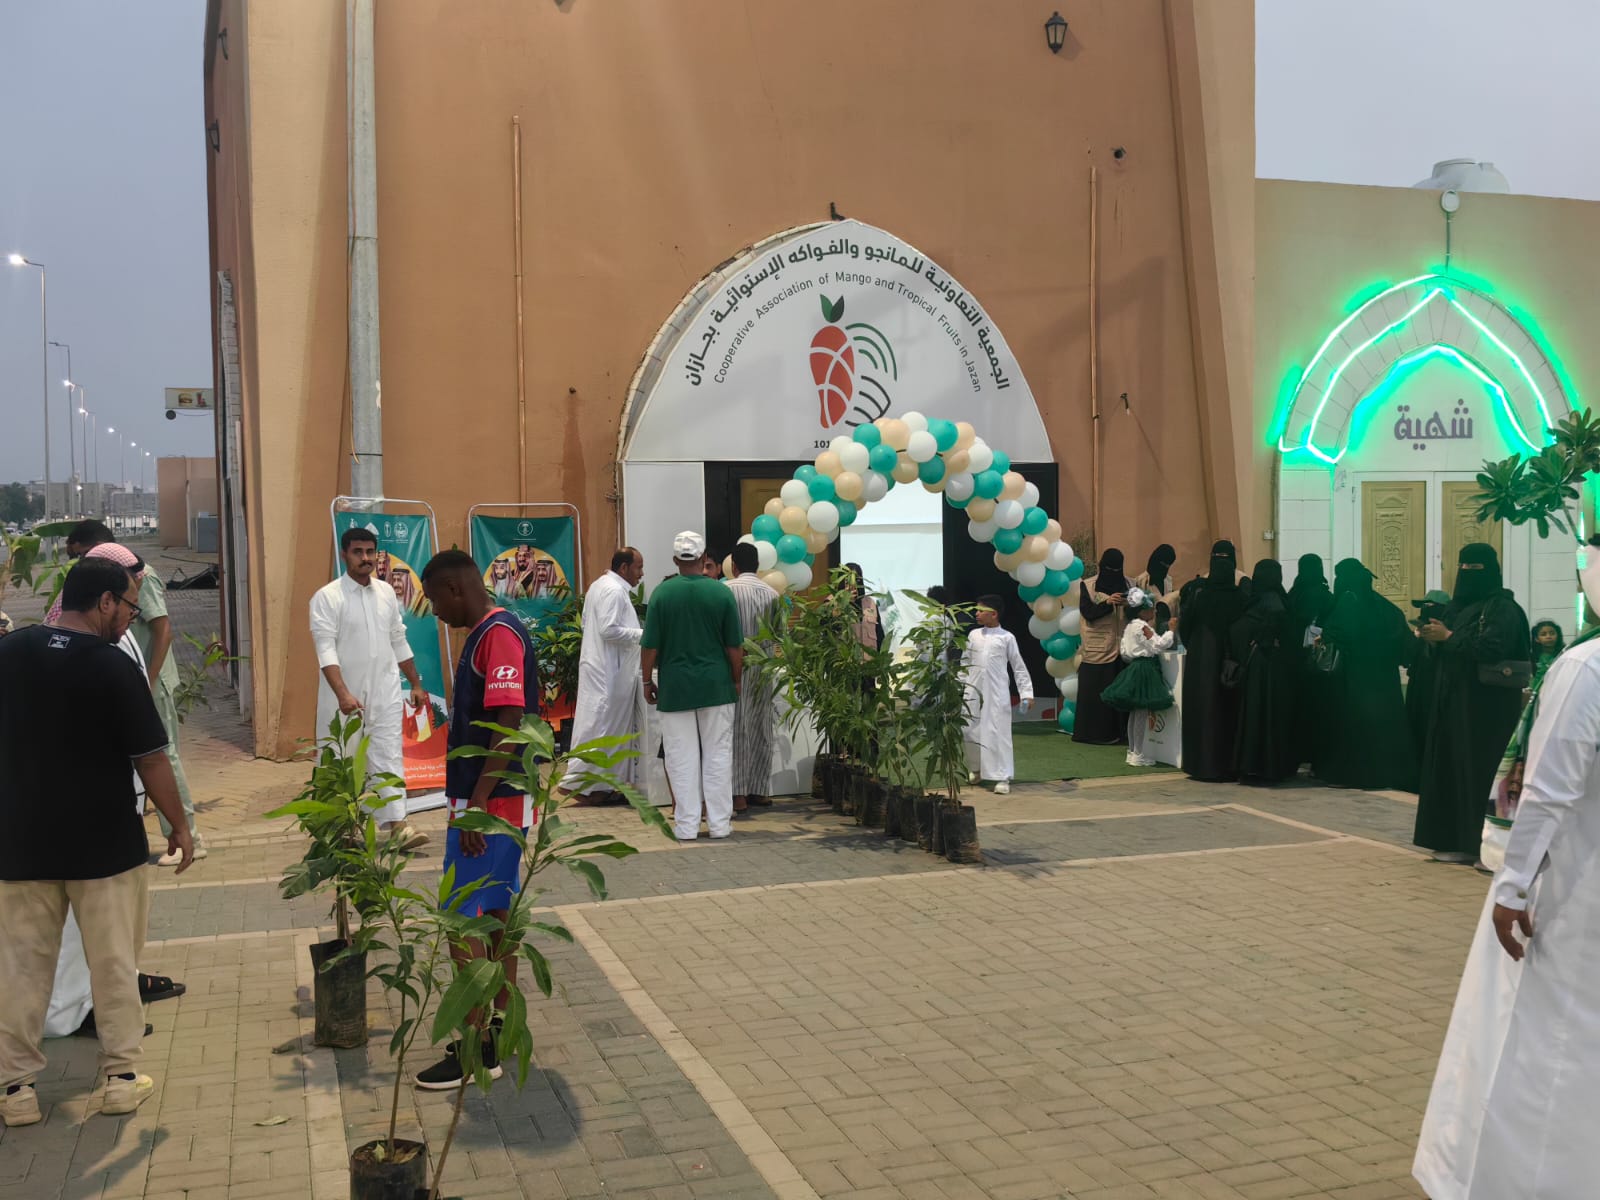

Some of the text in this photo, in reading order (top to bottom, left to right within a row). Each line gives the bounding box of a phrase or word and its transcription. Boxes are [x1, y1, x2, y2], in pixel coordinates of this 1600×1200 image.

[685, 238, 1010, 390] الجمعية التعاونية للمانجو والفواكه الإستوائية بجازان
[714, 271, 982, 392] Cooperative Association of Mango and Tropical Fruits in Jazan
[1394, 398, 1473, 451] شهية
[488, 681, 522, 690] HYUNDAI
